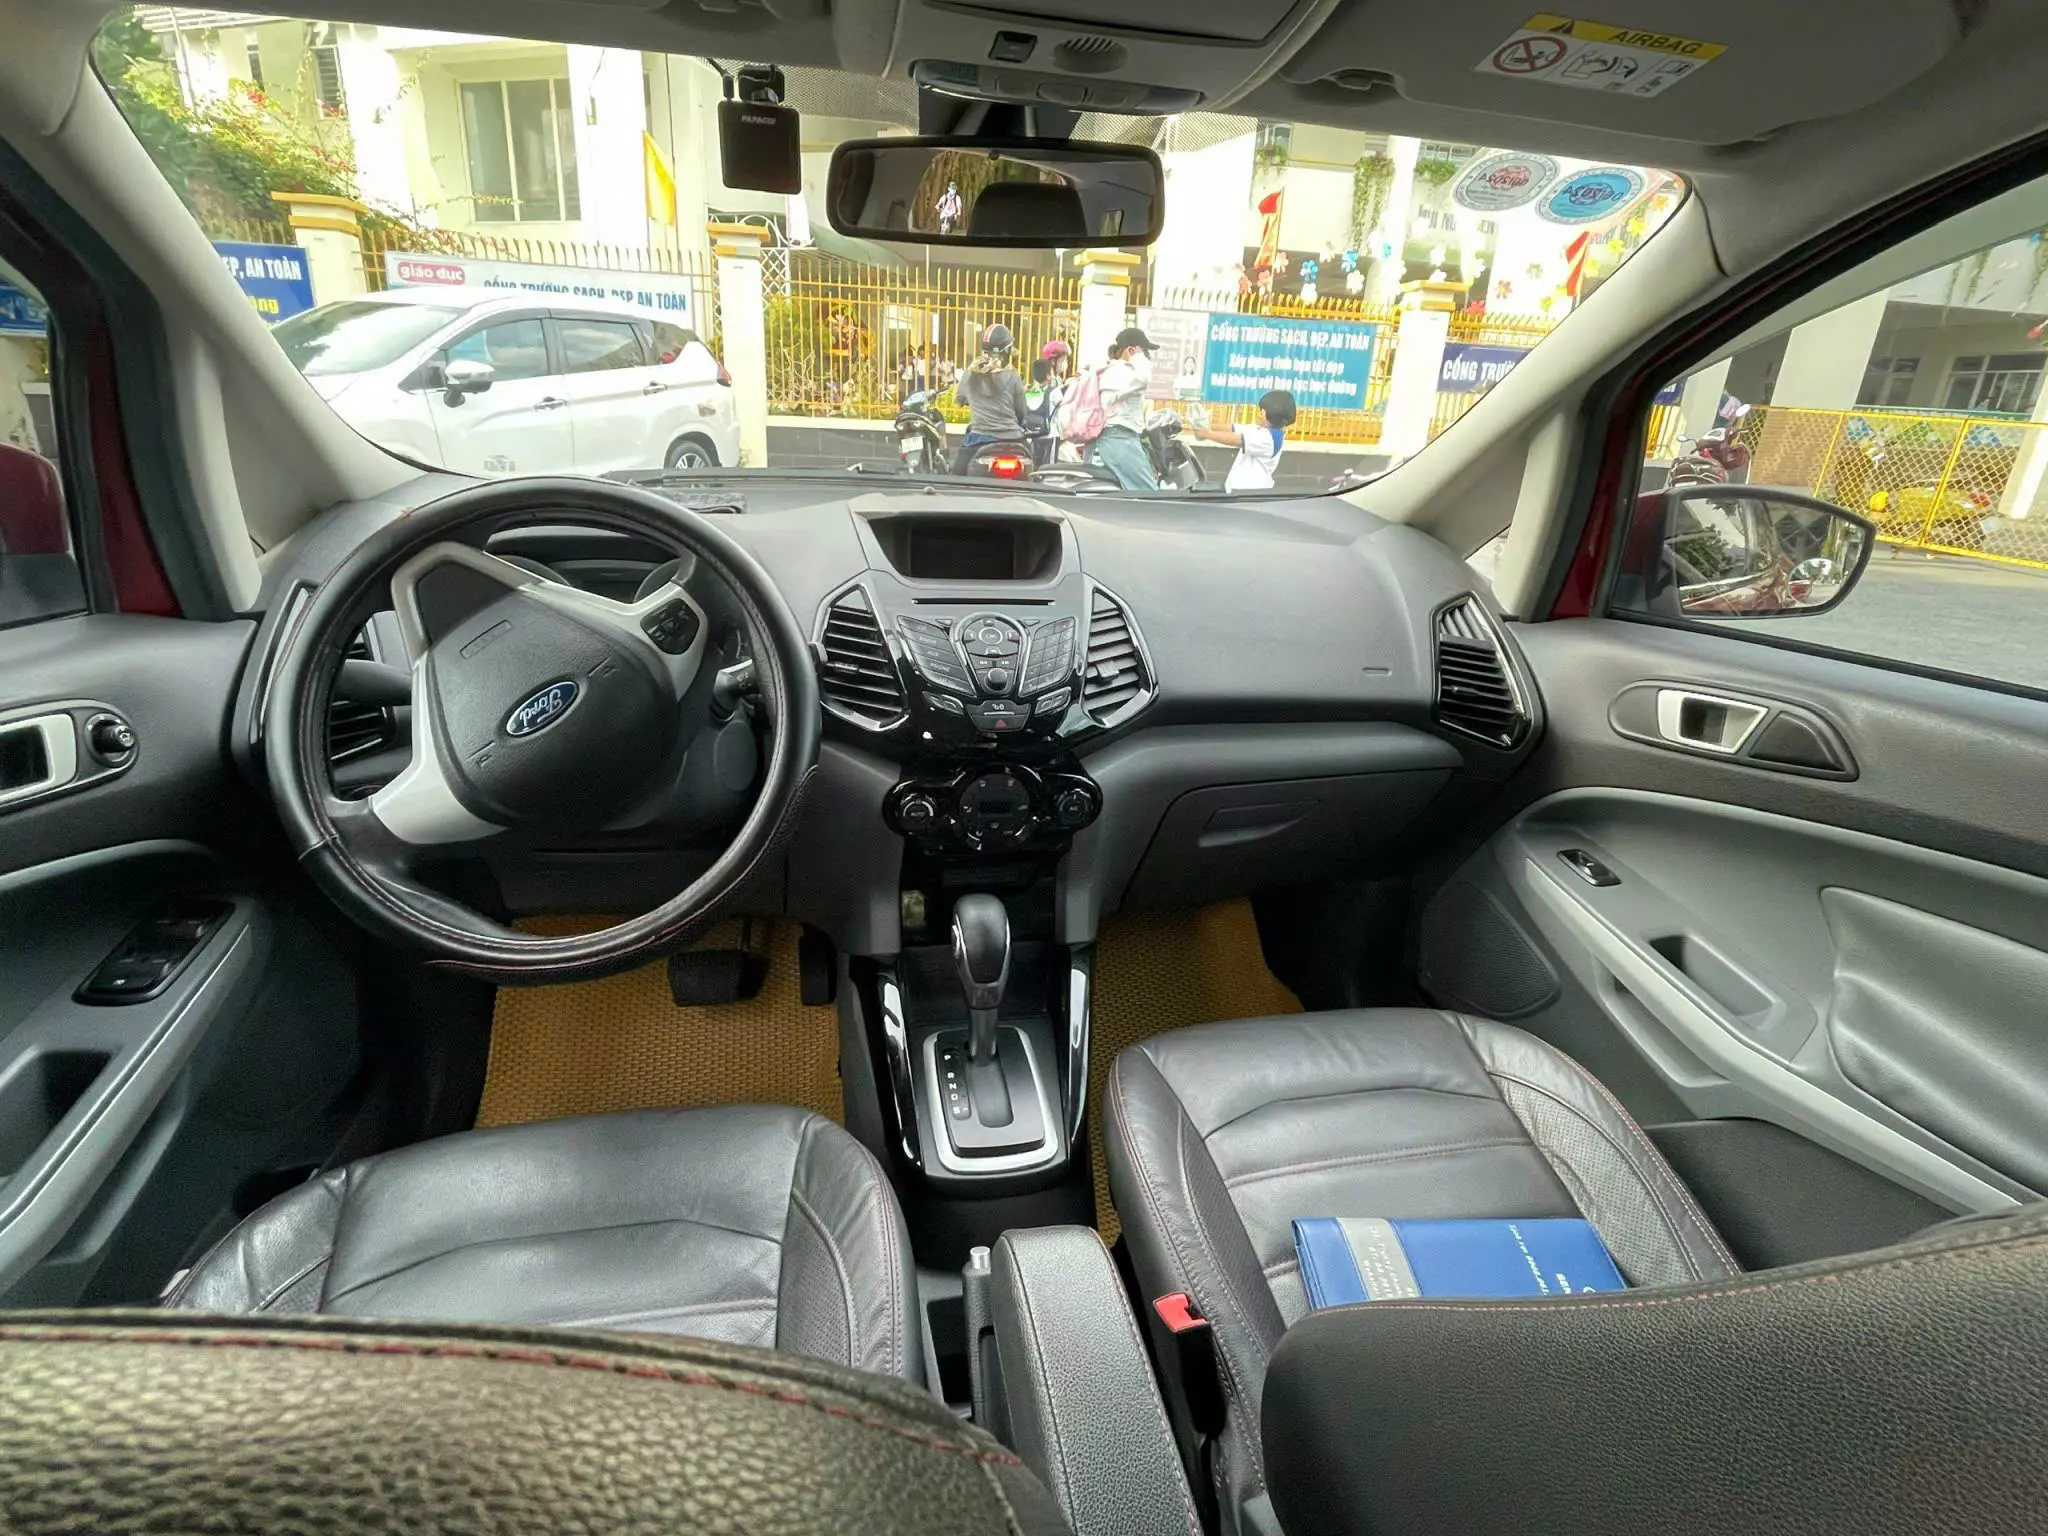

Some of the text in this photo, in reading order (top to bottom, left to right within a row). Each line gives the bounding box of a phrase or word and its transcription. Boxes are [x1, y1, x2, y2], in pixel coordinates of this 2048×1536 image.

[1608, 30, 1704, 55] AIRBAG
[245, 257, 265, 278] AN
[264, 255, 302, 280] TOÀN
[656, 291, 687, 311] TOÀN
[519, 688, 563, 728] Ford
[947, 1071, 955, 1079] R
[949, 1082, 957, 1090] N
